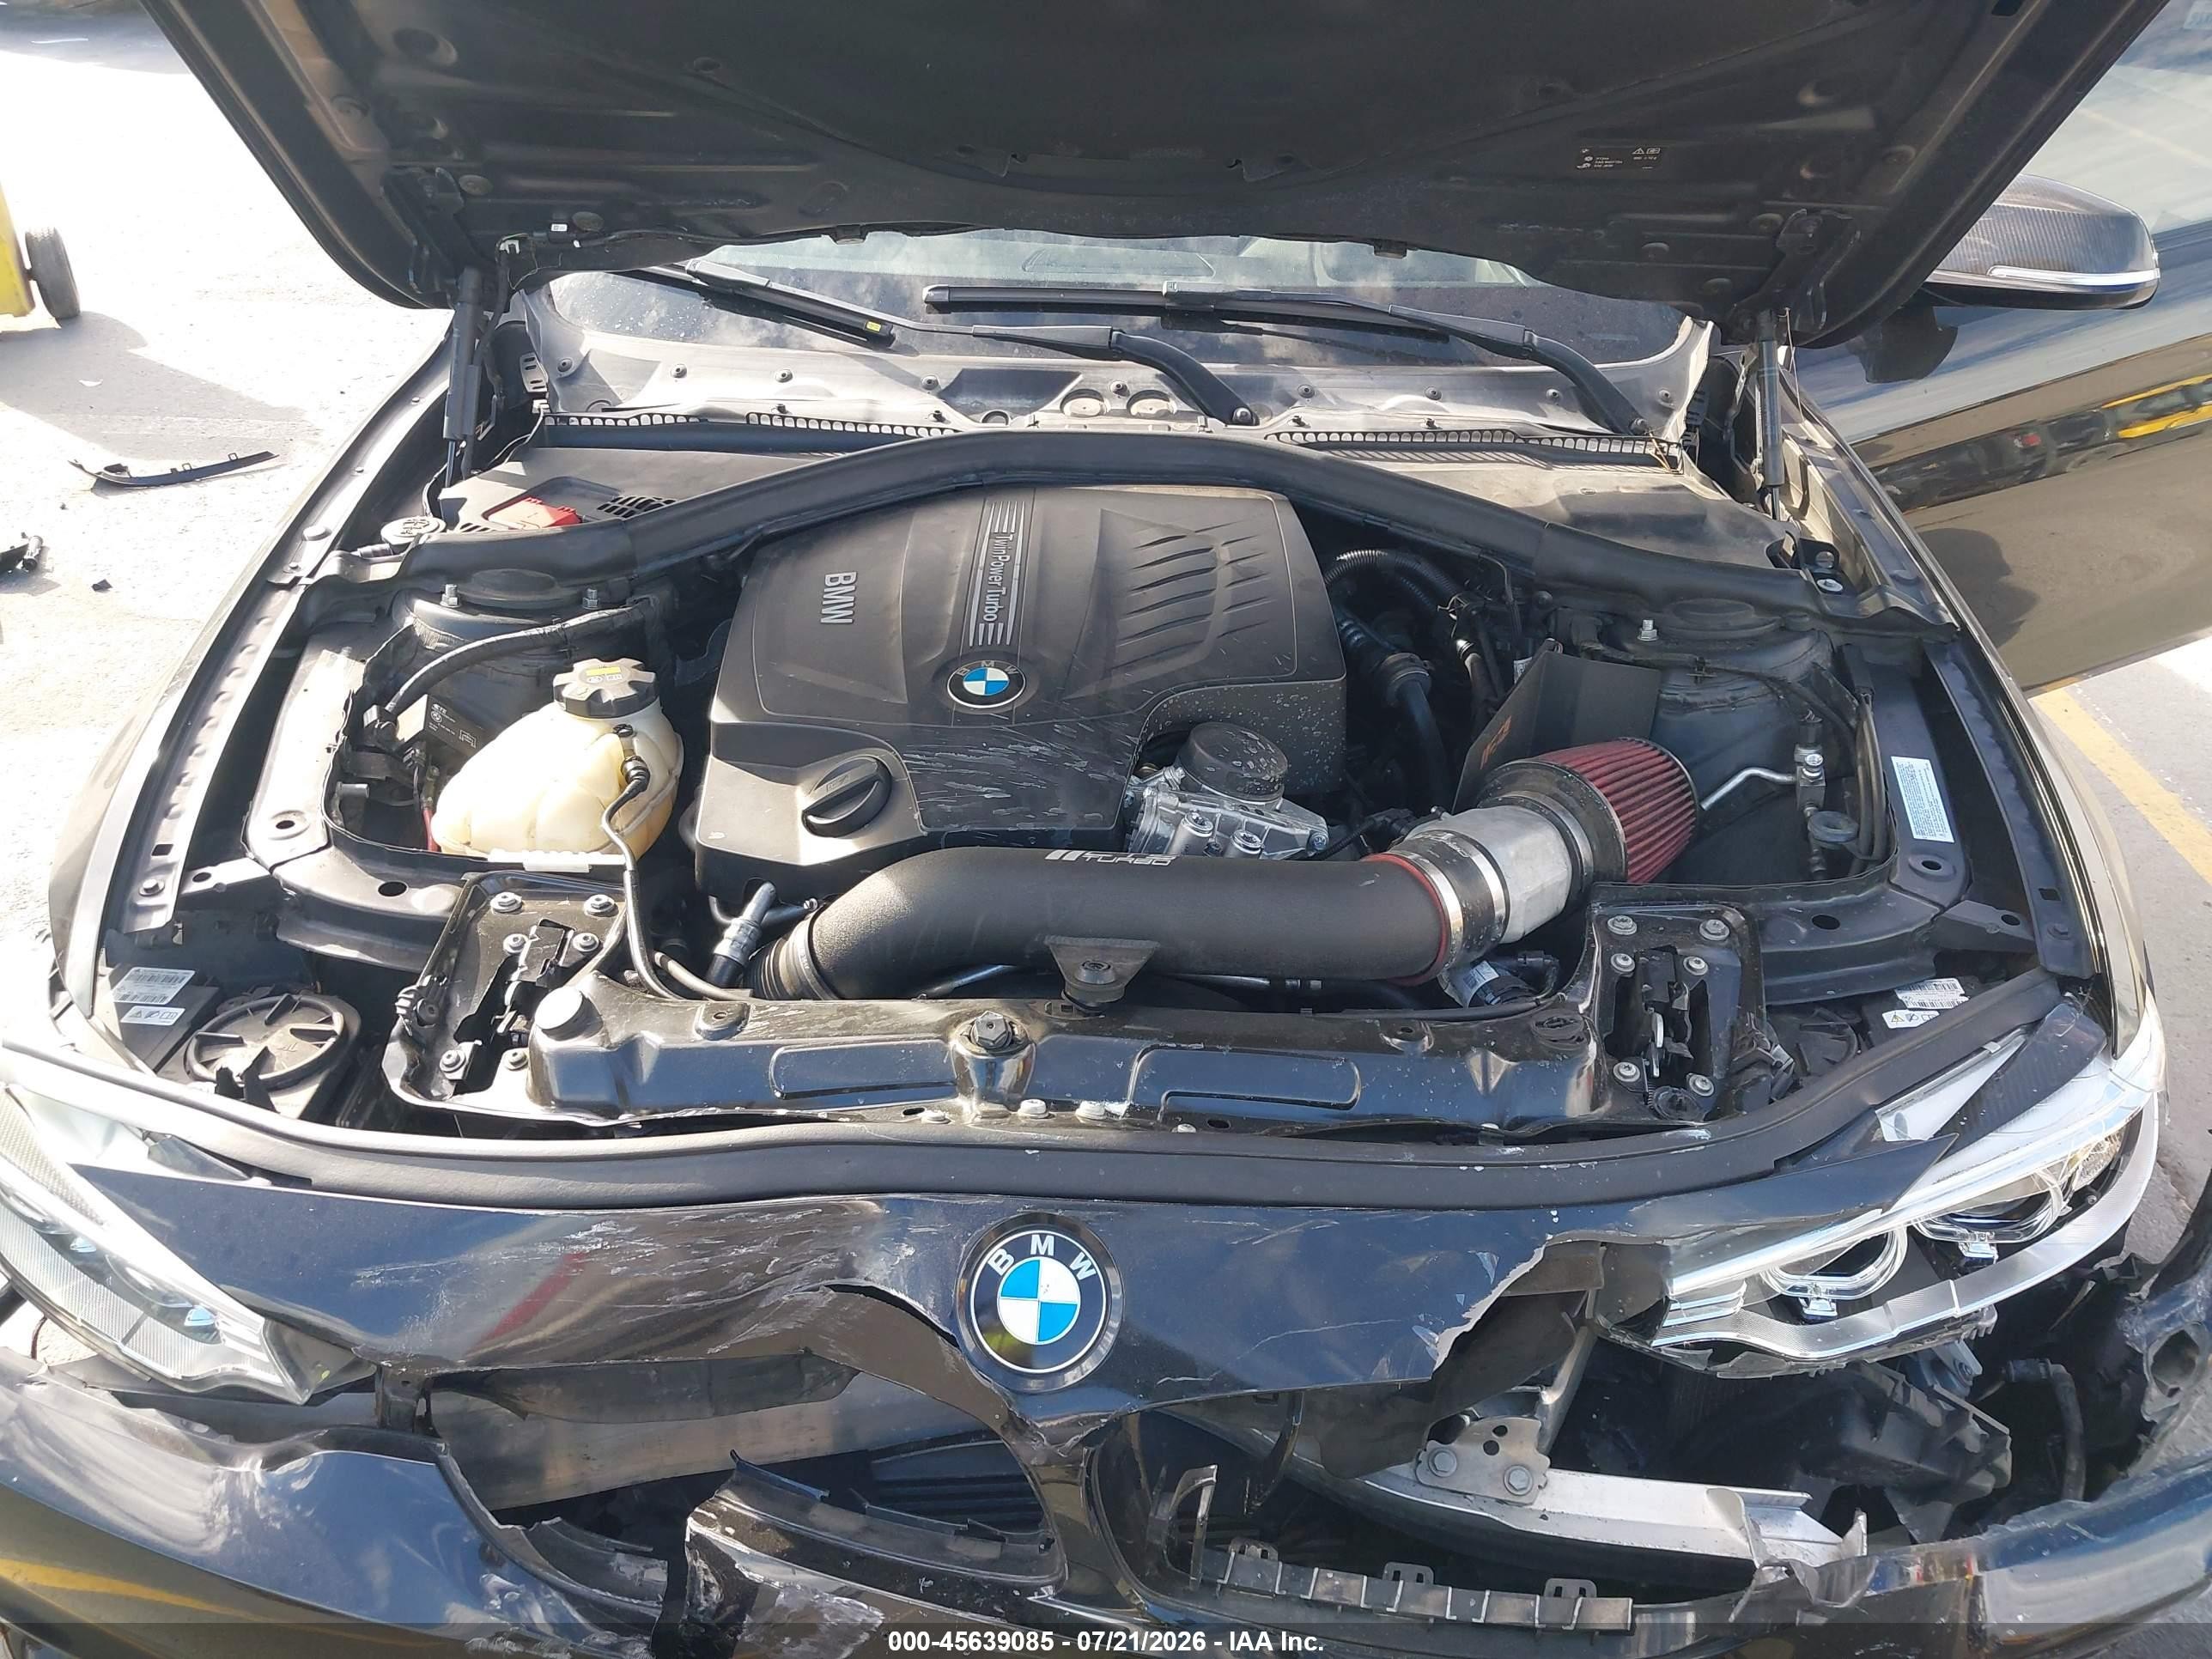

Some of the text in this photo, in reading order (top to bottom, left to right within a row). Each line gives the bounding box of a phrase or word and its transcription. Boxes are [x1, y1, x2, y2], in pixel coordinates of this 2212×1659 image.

[820, 571, 857, 623] BMW
[983, 534, 1014, 622] TwinPower Turbo
[955, 659, 1019, 677] BMW
[1081, 854, 1173, 866] TURBO
[987, 1234, 1097, 1281] BMW
